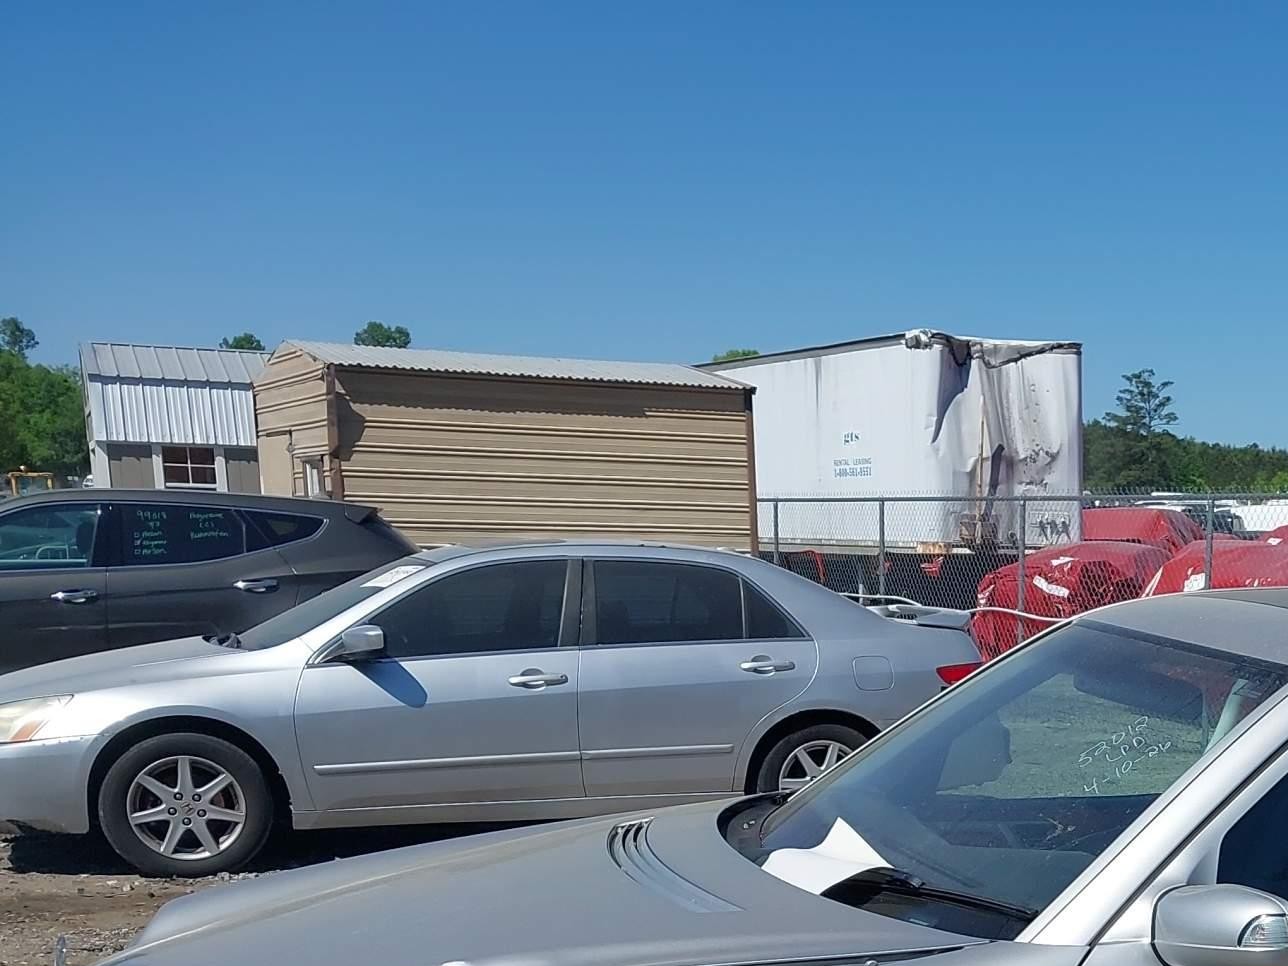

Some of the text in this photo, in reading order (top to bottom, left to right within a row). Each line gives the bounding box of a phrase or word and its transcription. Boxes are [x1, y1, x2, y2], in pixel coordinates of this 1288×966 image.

[844, 432, 860, 446] gts
[853, 457, 872, 465] LEASING
[1078, 716, 1149, 768] 52012
[1083, 741, 1172, 794] 4-10-26
